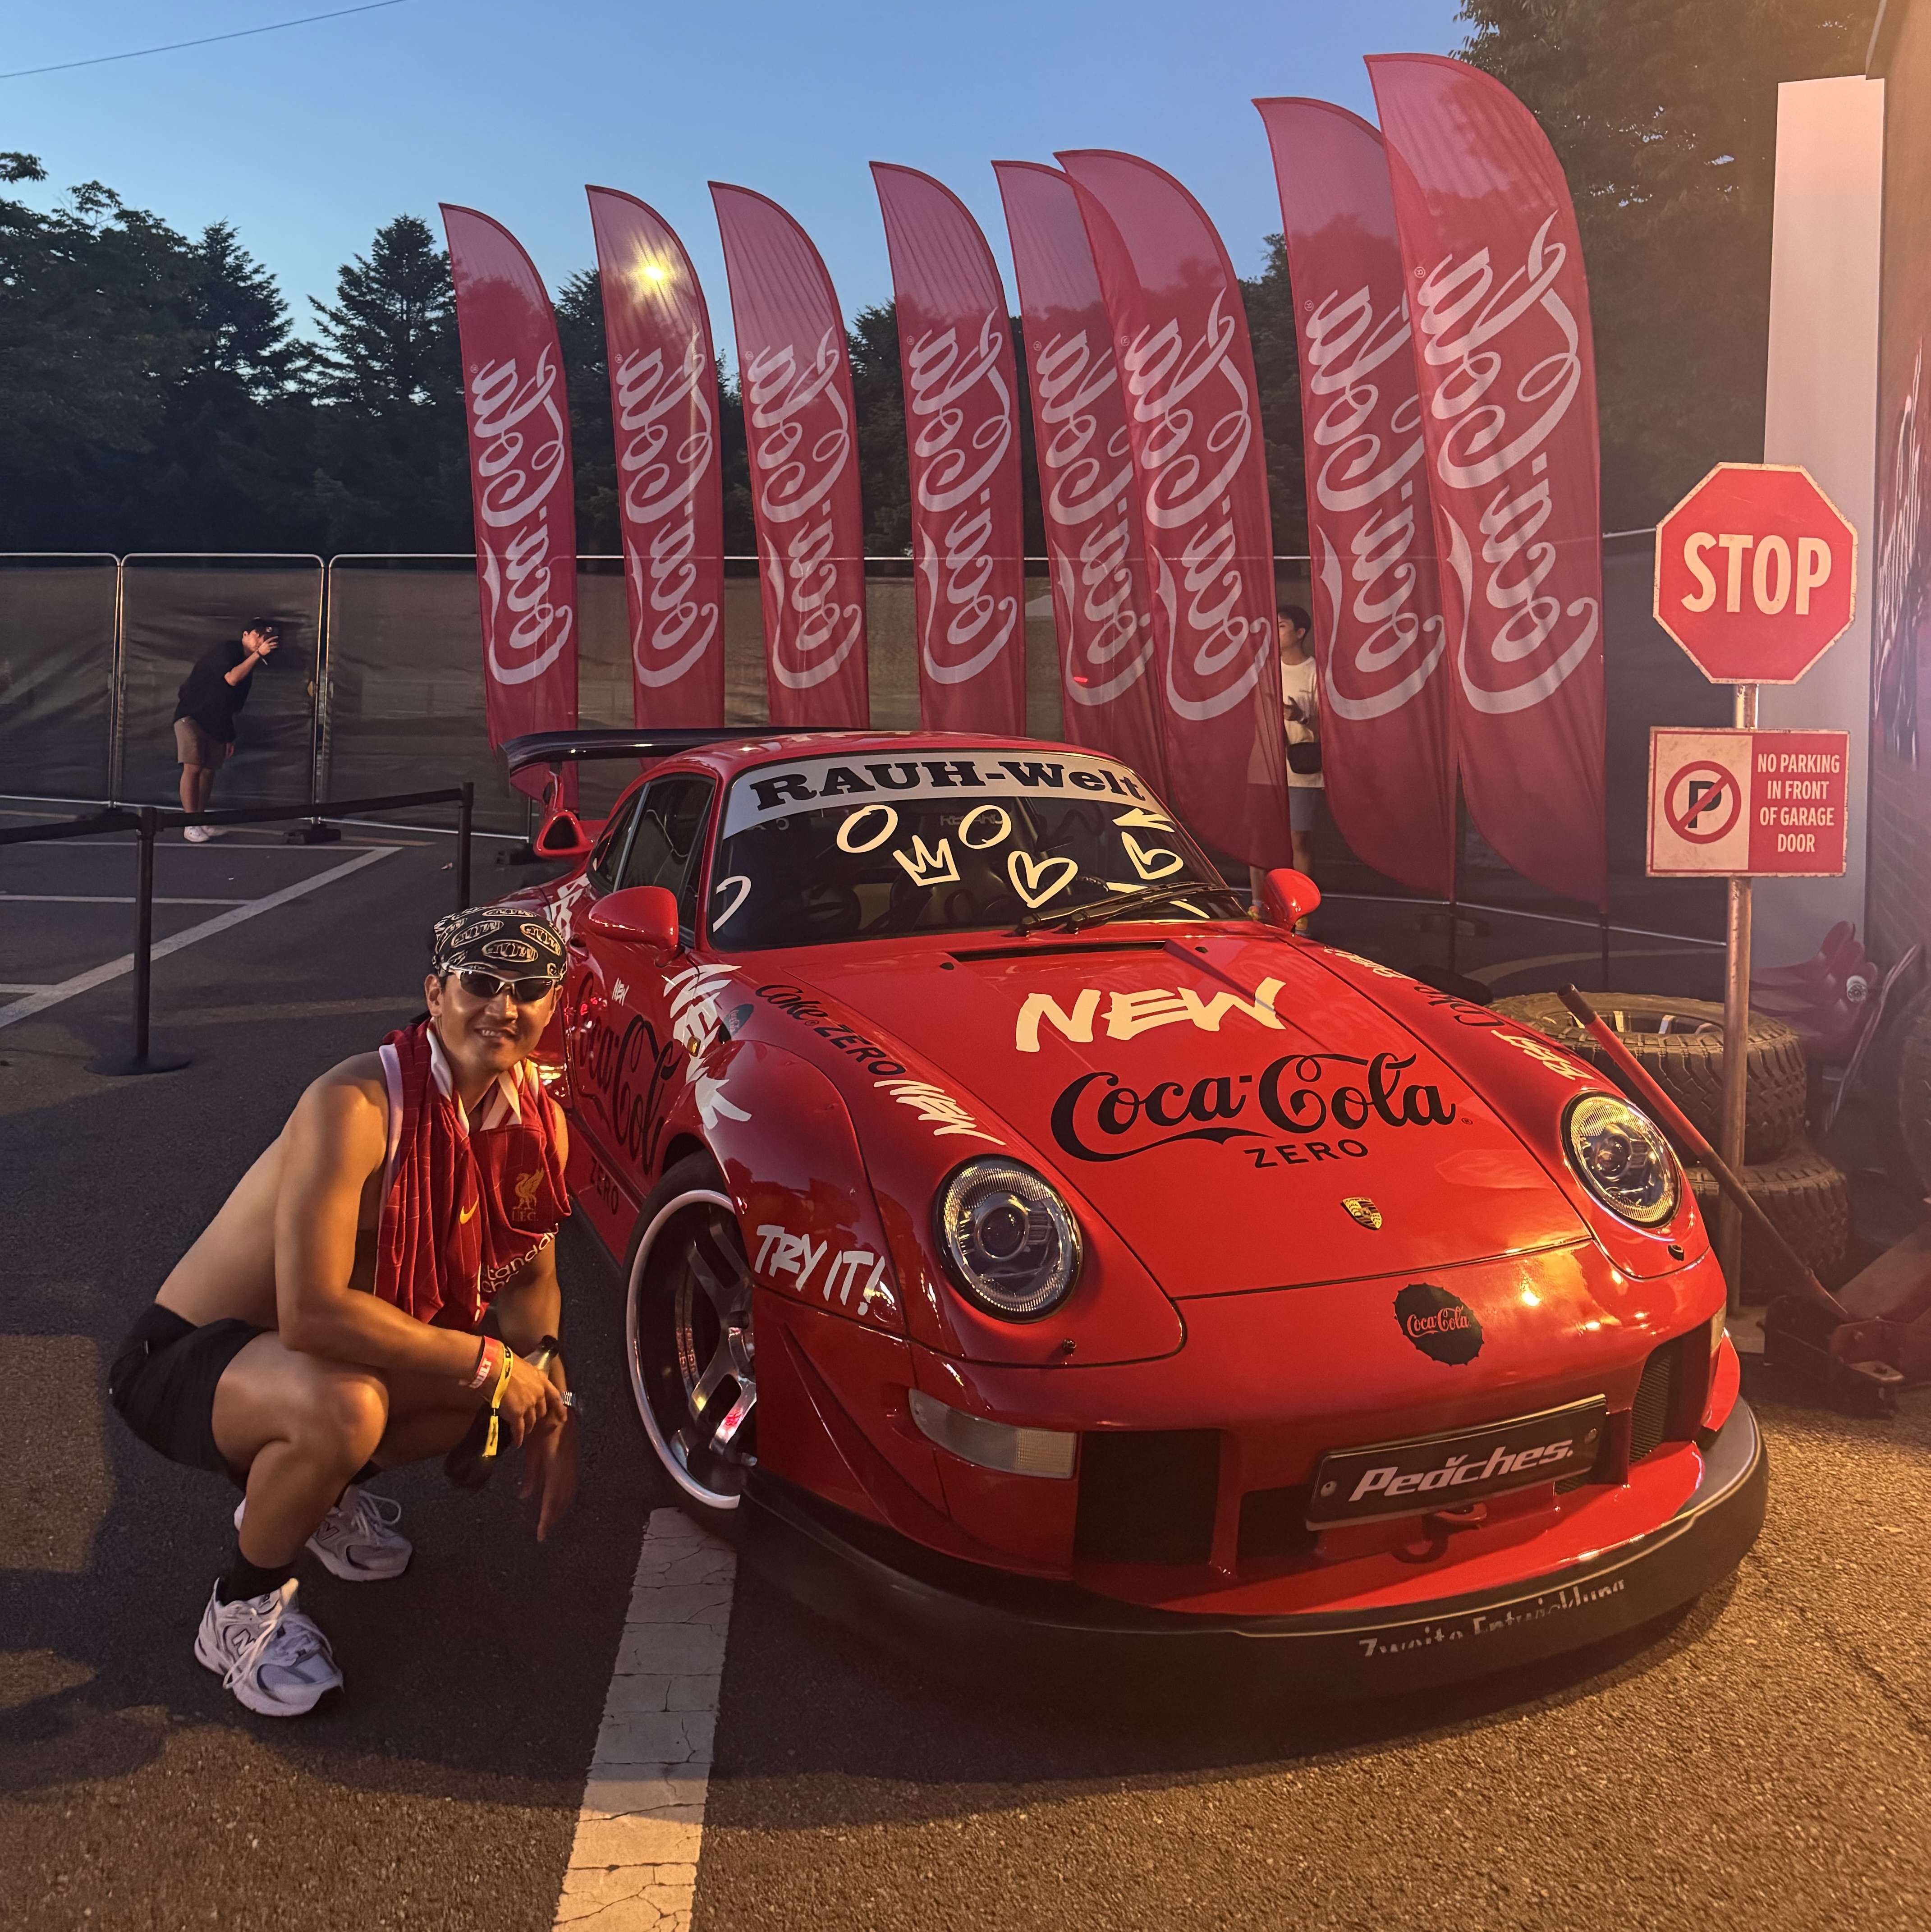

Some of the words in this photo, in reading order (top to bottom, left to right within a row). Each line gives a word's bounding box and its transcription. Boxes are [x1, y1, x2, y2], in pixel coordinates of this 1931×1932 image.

[1681, 532, 1831, 615] STOP
[1757, 753, 1778, 773] NO
[1780, 754, 1839, 773] PARKING
[750, 761, 1145, 811] RAUH-Welt
[1767, 780, 1782, 799] IN
[1785, 780, 1829, 800] FRONT
[1760, 806, 1777, 826] OF
[1780, 807, 1834, 826] GARAGE
[1778, 833, 1815, 852] DOOR
[1015, 977, 1286, 1052] NEW
[814, 1024, 906, 1075] ZERO
[1050, 1052, 1457, 1162] Coca-Cola
[1244, 1139, 1368, 1169] ZERO
[754, 1225, 828, 1292] TRY
[823, 1250, 885, 1316] IT!
[1407, 1305, 1469, 1338] Coca-Cola
